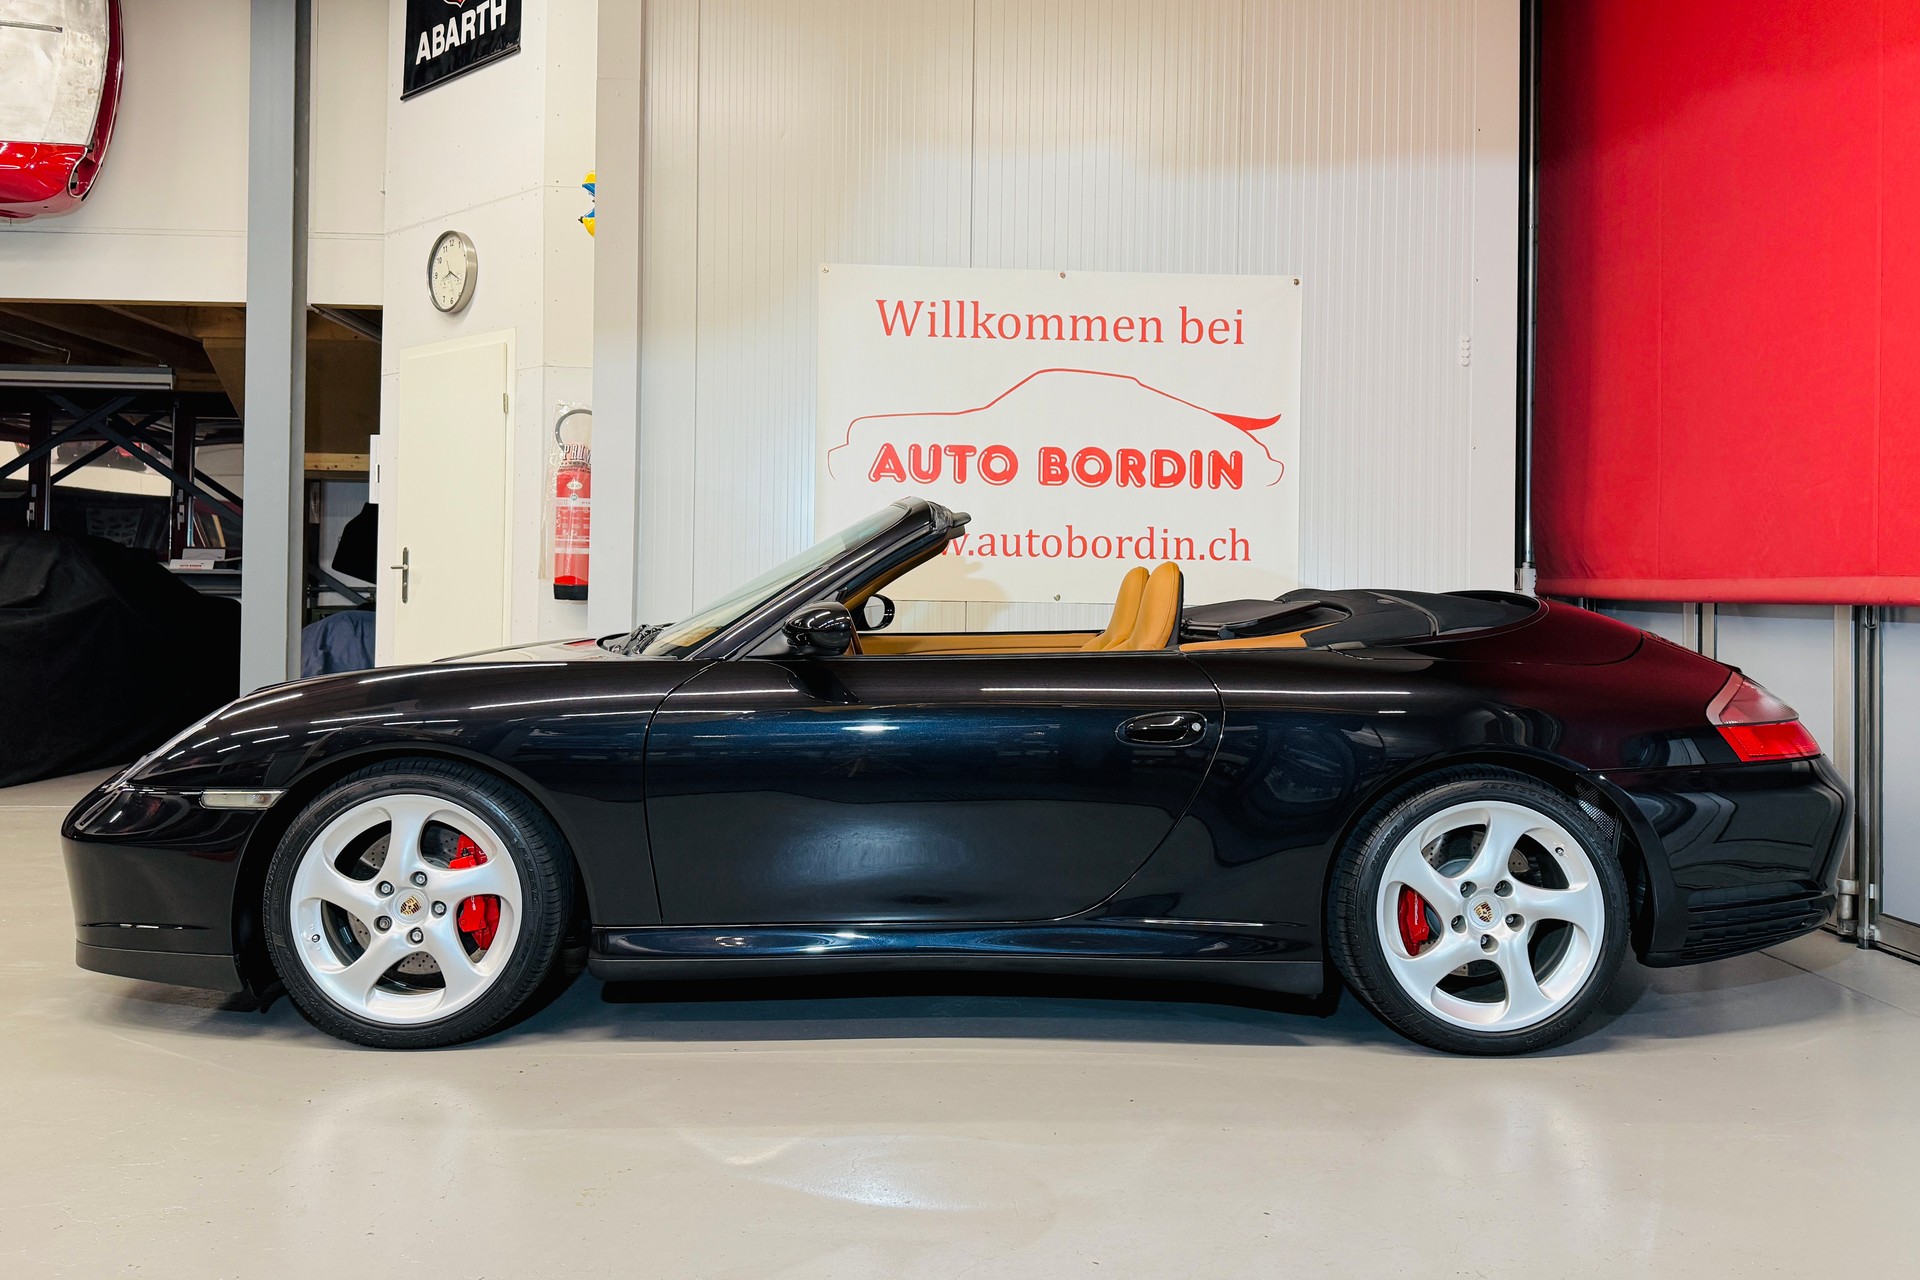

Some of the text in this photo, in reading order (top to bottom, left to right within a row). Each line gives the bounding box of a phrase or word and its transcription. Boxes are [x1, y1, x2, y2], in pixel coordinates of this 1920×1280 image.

[415, 0, 507, 66] ABARTH
[449, 239, 455, 247] 12
[875, 299, 1245, 345] Willkommen bei
[868, 442, 1244, 490] AUTO BORDIN
